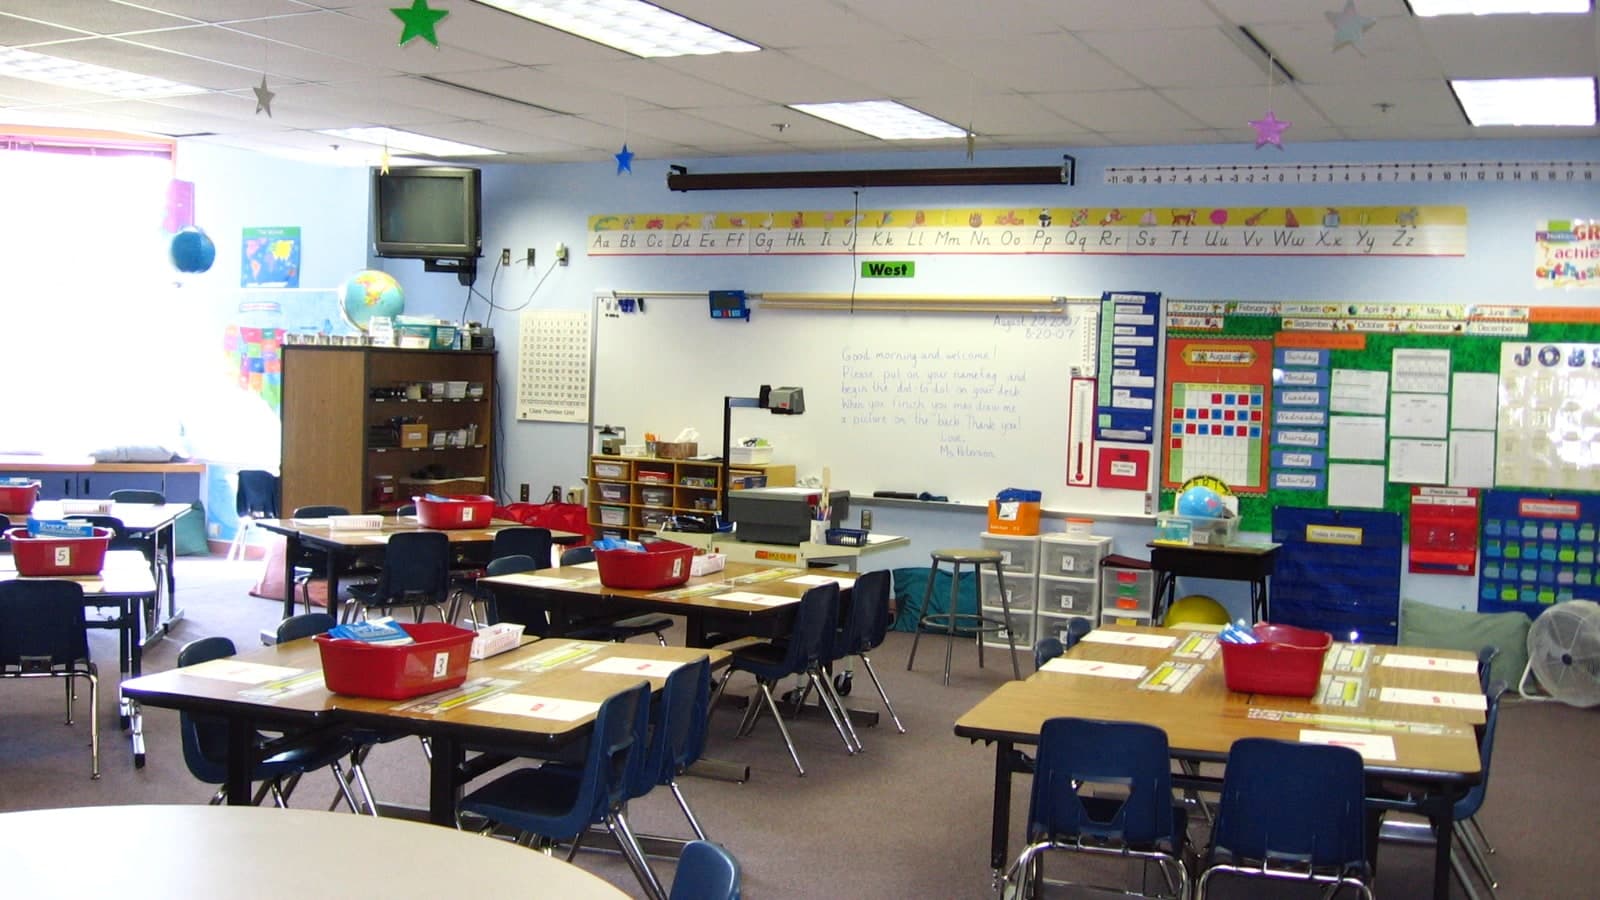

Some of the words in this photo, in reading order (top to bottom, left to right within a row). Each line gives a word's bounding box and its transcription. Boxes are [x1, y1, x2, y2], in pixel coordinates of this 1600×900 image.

[593, 232, 609, 248] Aa
[620, 232, 636, 248] Bb
[647, 232, 663, 247] Cc
[672, 232, 690, 248] Dd
[700, 232, 715, 247] Ee
[726, 232, 745, 247] Ff
[755, 232, 773, 253] Gg
[786, 232, 806, 247] Hh
[821, 232, 832, 247] Ii
[872, 232, 894, 247] Kk
[907, 232, 924, 247] Ll
[935, 231, 960, 246] Mm
[970, 231, 990, 246] Nn
[1001, 230, 1020, 246] Oo
[1033, 231, 1052, 251] Pp
[1065, 231, 1088, 252] Qq
[1100, 230, 1120, 246] Rr
[1136, 230, 1156, 246] Ss
[1170, 229, 1189, 246] Tt
[1205, 229, 1228, 246] Uu
[1243, 230, 1264, 246] Vv
[1274, 230, 1304, 246] Ww
[1315, 230, 1342, 247] Xx
[1356, 230, 1375, 252] Yy
[1392, 230, 1415, 247] Zz
[868, 262, 908, 276] West
[1183, 303, 1209, 313] January
[1238, 303, 1268, 313] February
[1300, 304, 1321, 313] March
[1363, 305, 1379, 315] April
[1426, 306, 1442, 316] May
[1488, 308, 1505, 317] June
[1293, 319, 1329, 330] September
[1357, 321, 1385, 330] October
[1415, 322, 1450, 331] November
[1477, 324, 1513, 333] December
[841, 348, 870, 361] Good
[875, 350, 918, 368] morning
[920, 347, 940, 360] and
[1208, 352, 1232, 362] August
[1287, 351, 1317, 364] Sunday
[842, 365, 873, 380] Please
[884, 368, 901, 384] put
[928, 371, 949, 386] your
[953, 367, 998, 384] nametag
[1007, 370, 1027, 382] and
[1284, 371, 1315, 384] Monday
[841, 382, 868, 399] begin
[972, 385, 994, 399] your
[841, 397, 865, 409] When
[1284, 391, 1317, 405] Tuesday
[852, 412, 887, 426] picture
[914, 412, 929, 425] the
[968, 415, 995, 431] Thank
[1277, 412, 1324, 425] Wednesday
[1279, 431, 1318, 446] Thursday
[1284, 453, 1311, 466] Friday
[1277, 474, 1315, 488] Saturday
[57, 550, 66, 562] 5
[436, 657, 445, 674] 3
